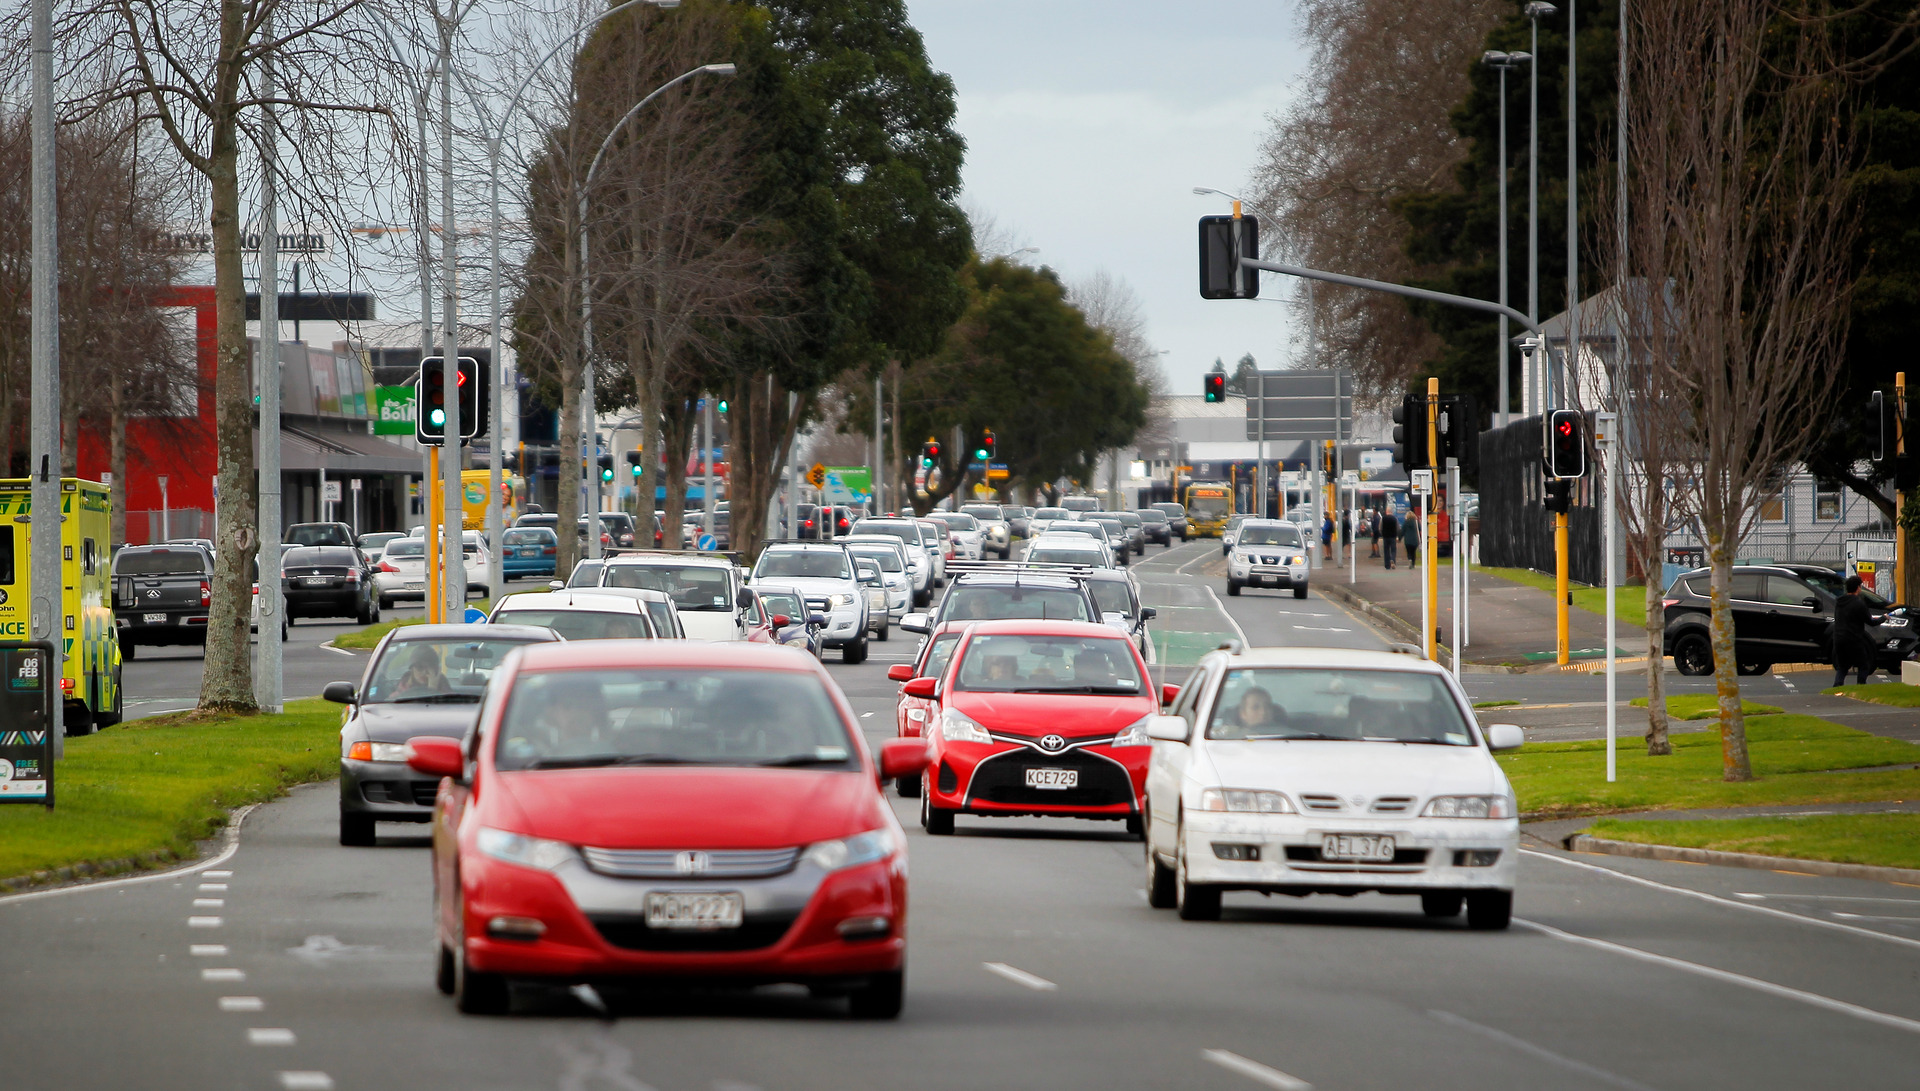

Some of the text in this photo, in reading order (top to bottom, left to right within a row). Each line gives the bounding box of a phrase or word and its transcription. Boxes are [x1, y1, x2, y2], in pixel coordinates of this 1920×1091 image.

[384, 399, 400, 407] the
[24, 658, 39, 668] 06
[19, 667, 39, 678] FEB
[16, 760, 39, 768] FREE
[1028, 771, 1076, 785] KCE729
[1324, 835, 1394, 856] AEL376
